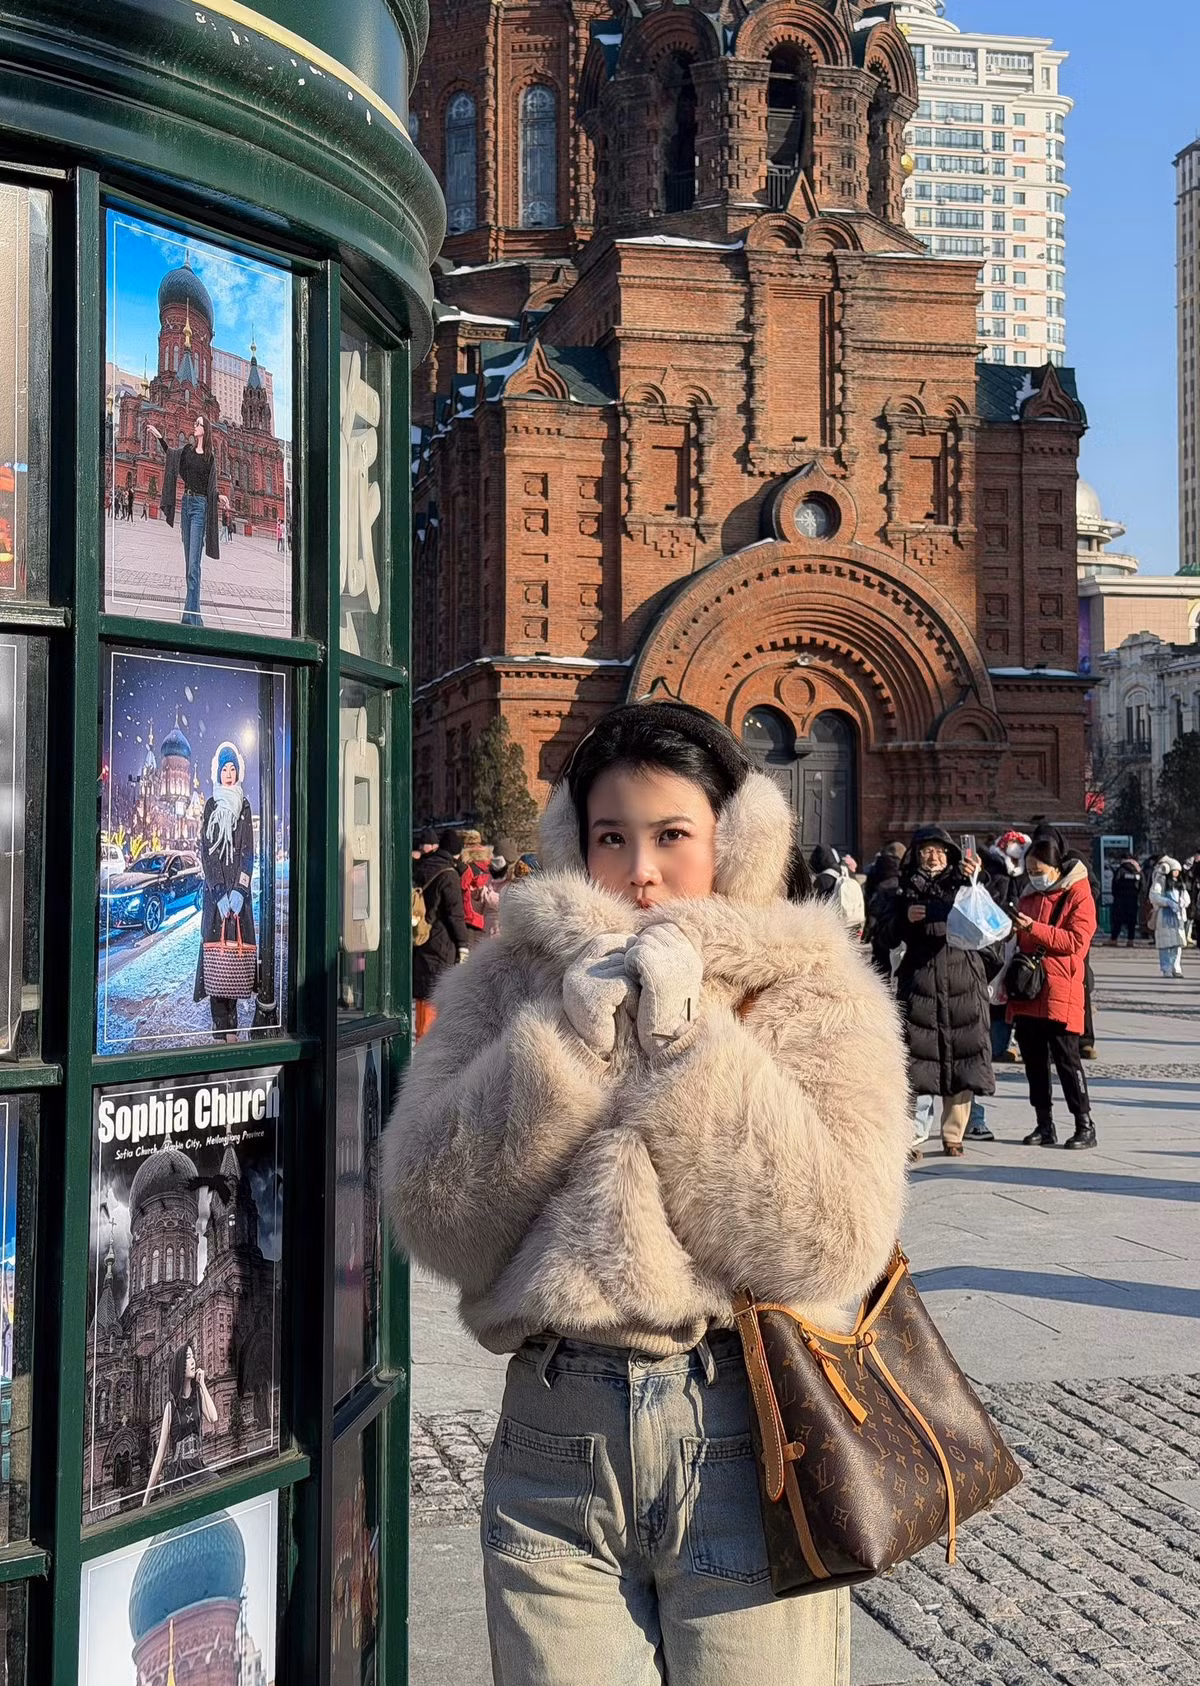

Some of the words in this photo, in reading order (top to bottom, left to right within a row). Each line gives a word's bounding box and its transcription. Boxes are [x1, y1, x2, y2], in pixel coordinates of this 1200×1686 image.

[97, 1093, 189, 1143] Sophia
[194, 1081, 280, 1129] Church
[114, 1149, 134, 1160] Sofia
[163, 1140, 184, 1152] Harbin
[185, 1138, 202, 1151] City,
[241, 1130, 265, 1140] Province
